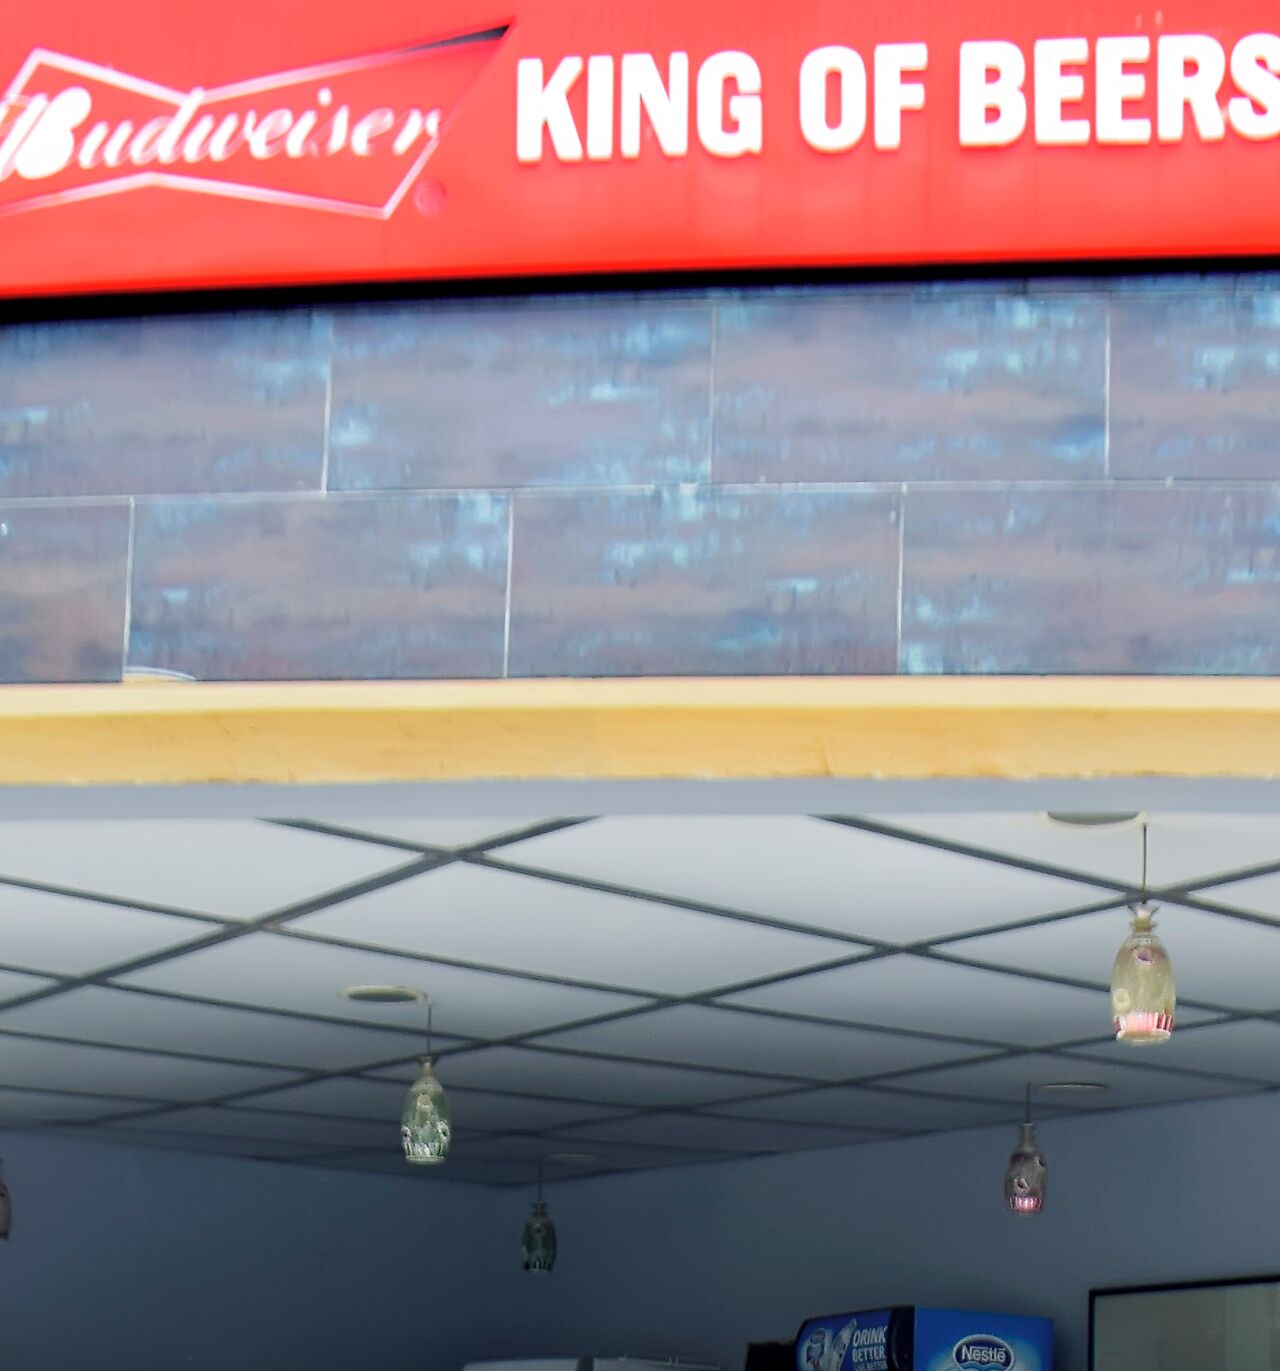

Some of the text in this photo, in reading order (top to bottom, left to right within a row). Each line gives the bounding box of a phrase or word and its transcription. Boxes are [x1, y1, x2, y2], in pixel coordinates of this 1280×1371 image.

[516, 50, 763, 163] KING
[799, 43, 928, 153] OF
[853, 1326, 888, 1347] DRINK
